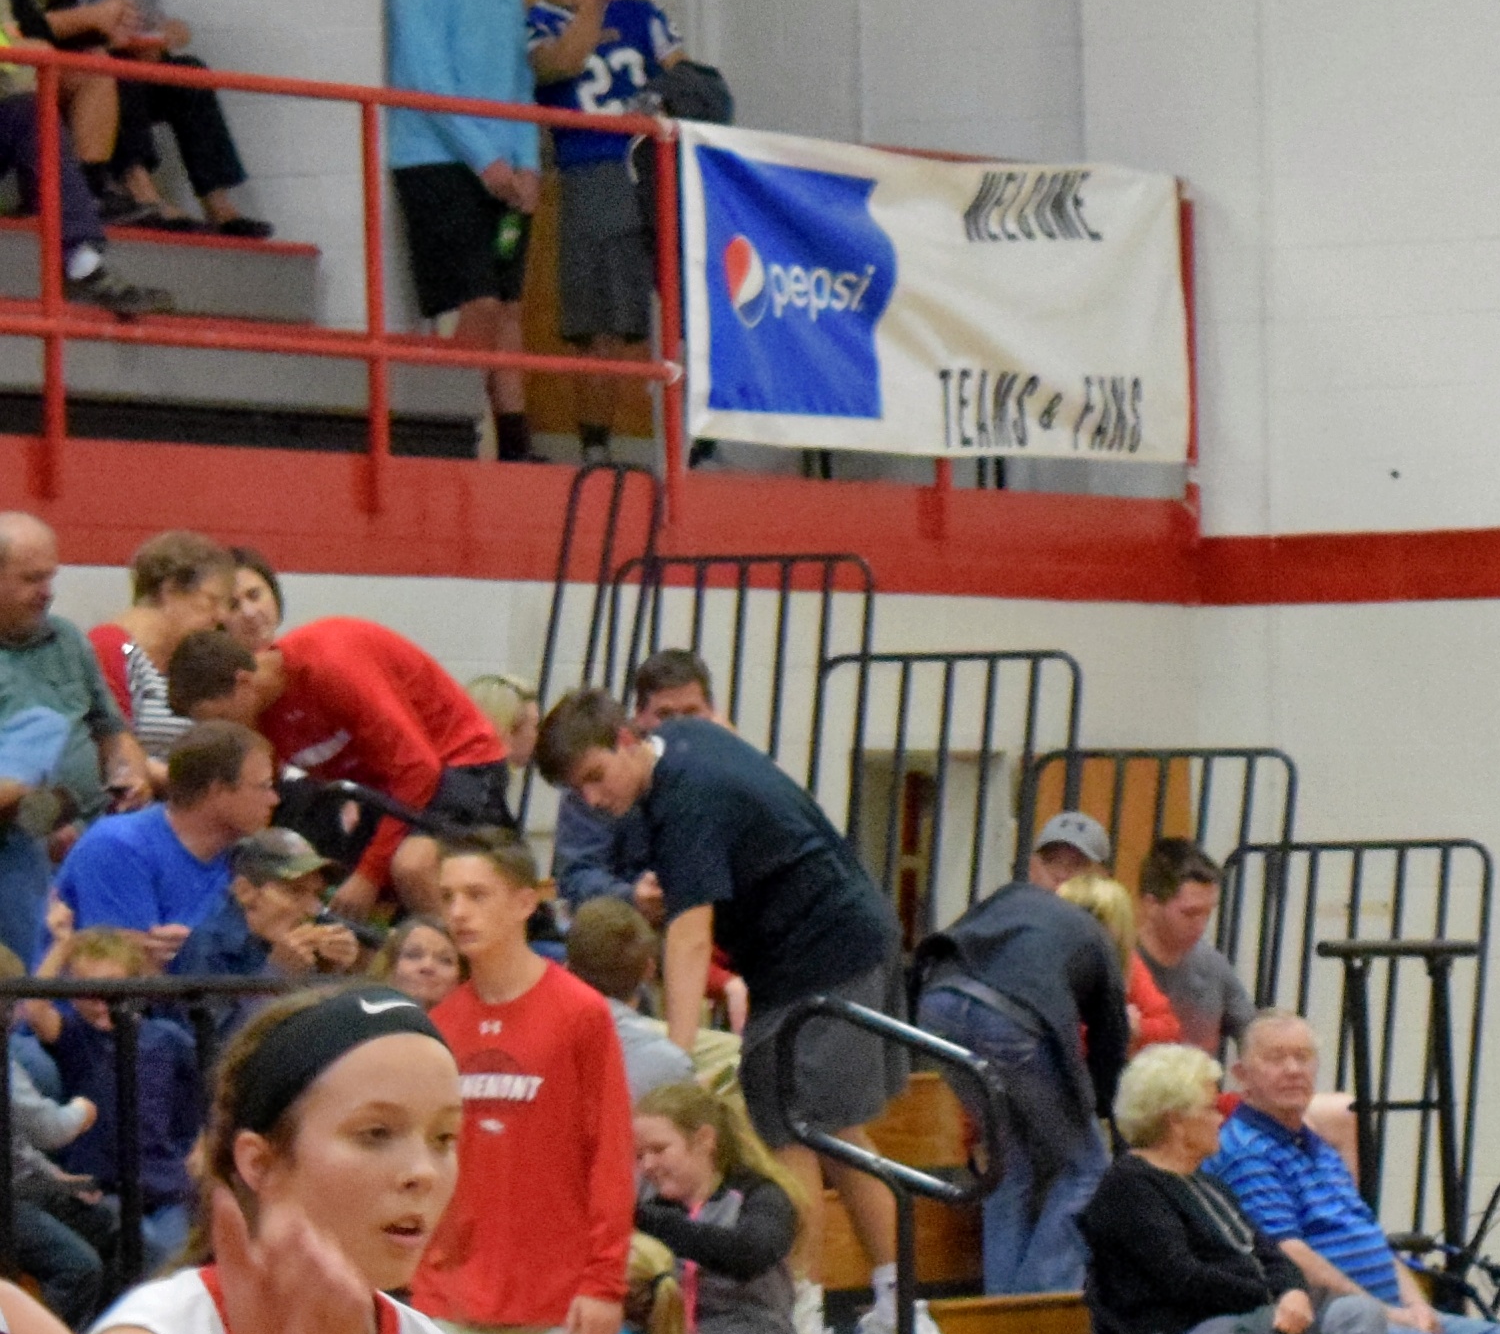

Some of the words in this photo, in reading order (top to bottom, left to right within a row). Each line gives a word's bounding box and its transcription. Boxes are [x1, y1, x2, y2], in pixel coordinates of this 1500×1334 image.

[766, 264, 876, 323] pepsi
[939, 368, 1040, 449] TEAMS
[1072, 375, 1143, 454] FANS
